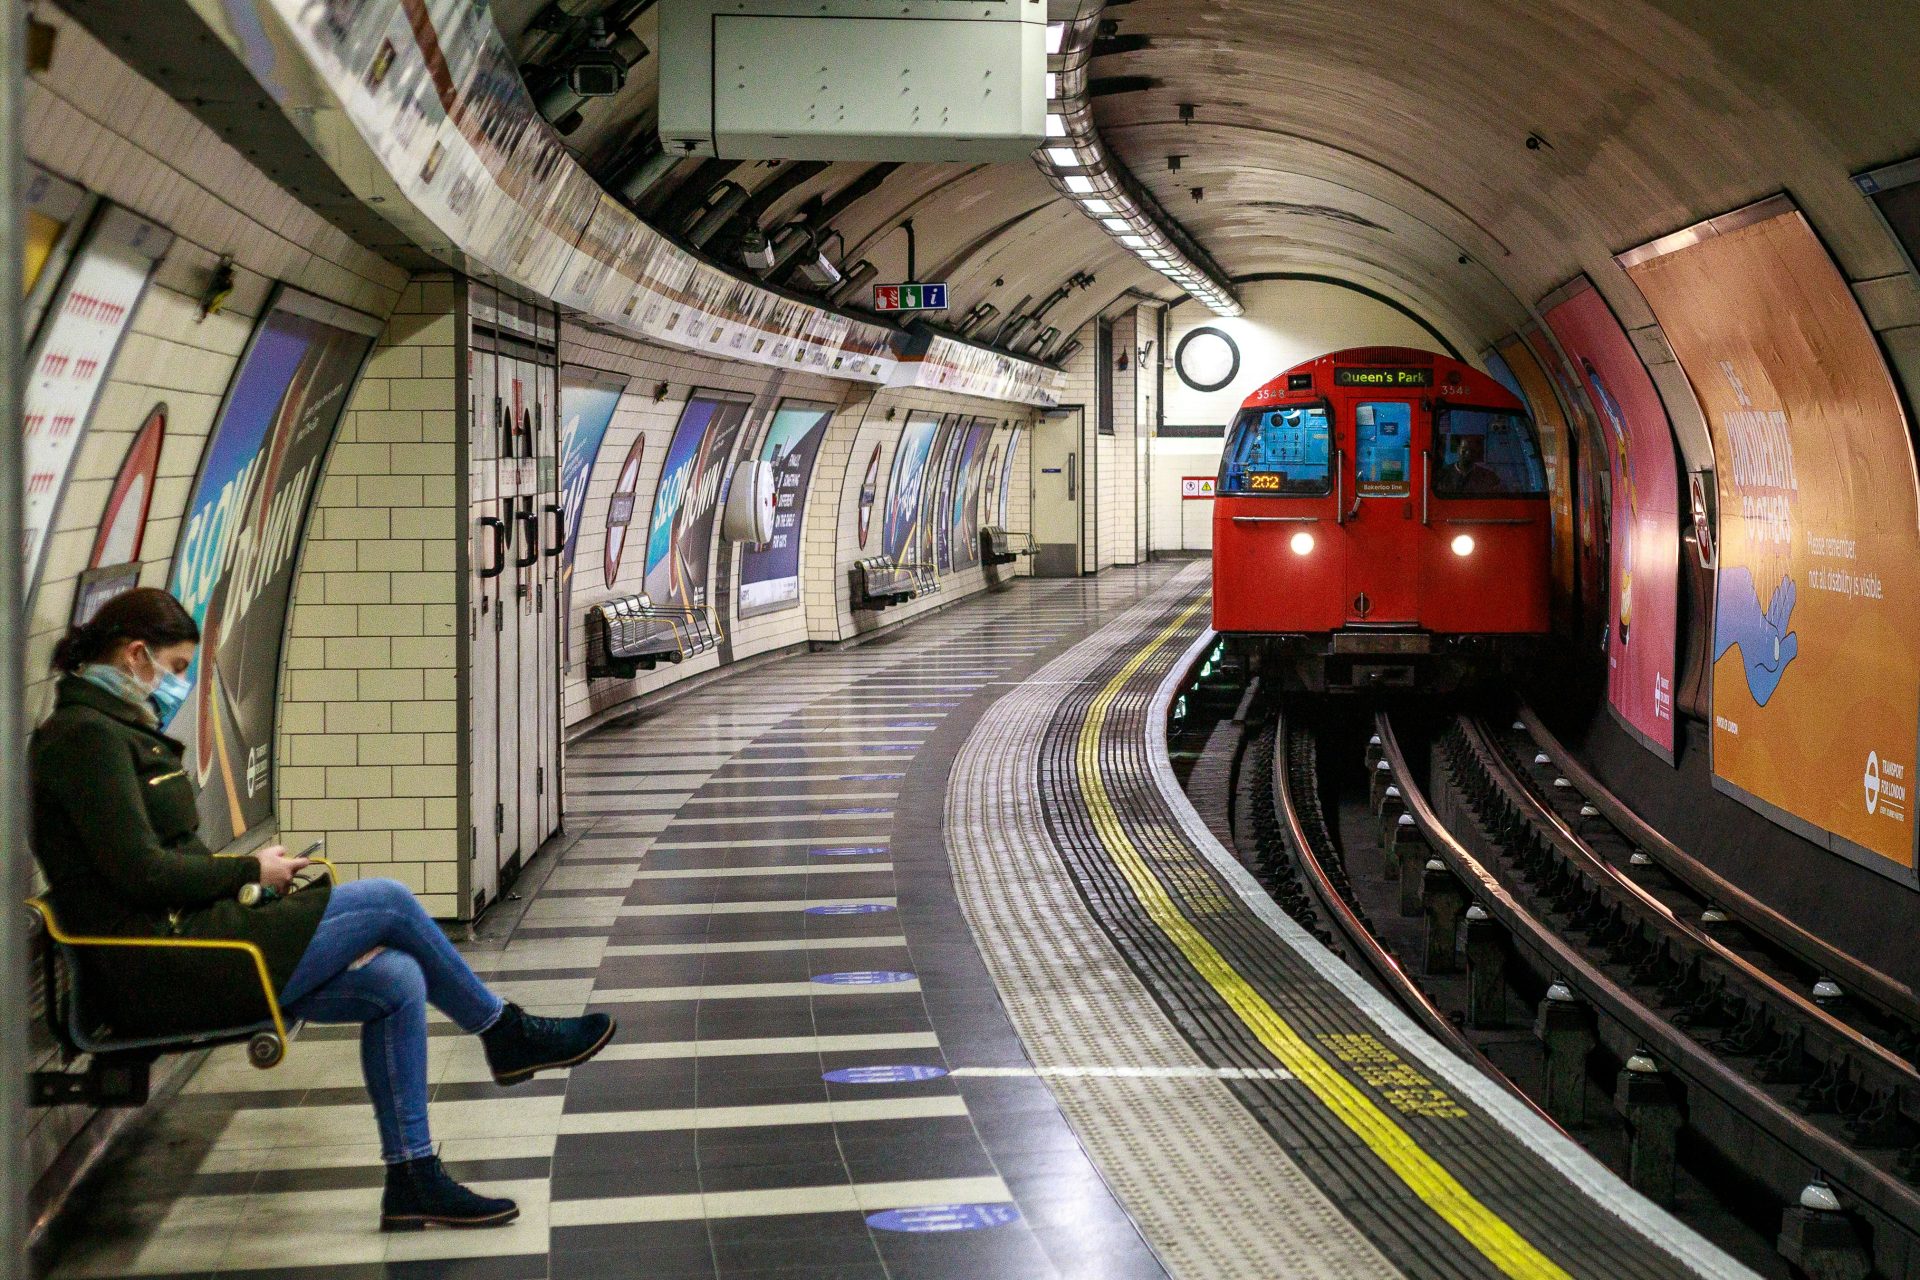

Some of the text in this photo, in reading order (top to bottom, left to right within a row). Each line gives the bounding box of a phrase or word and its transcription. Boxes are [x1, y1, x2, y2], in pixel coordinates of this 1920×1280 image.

[1257, 389, 1285, 400] 3548
[1342, 371, 1425, 384] Queen's Park
[1724, 410, 1798, 491] CONSIDERATE
[654, 453, 698, 534] SLOW
[677, 456, 725, 541] DOWN
[1251, 475, 1279, 490] 202
[180, 448, 266, 617] SLOW
[1743, 495, 1792, 546] TO OTHERS
[1807, 530, 1825, 556] Please
[218, 454, 318, 650] DOWN
[1808, 565, 1884, 600] not all disability is visible.
